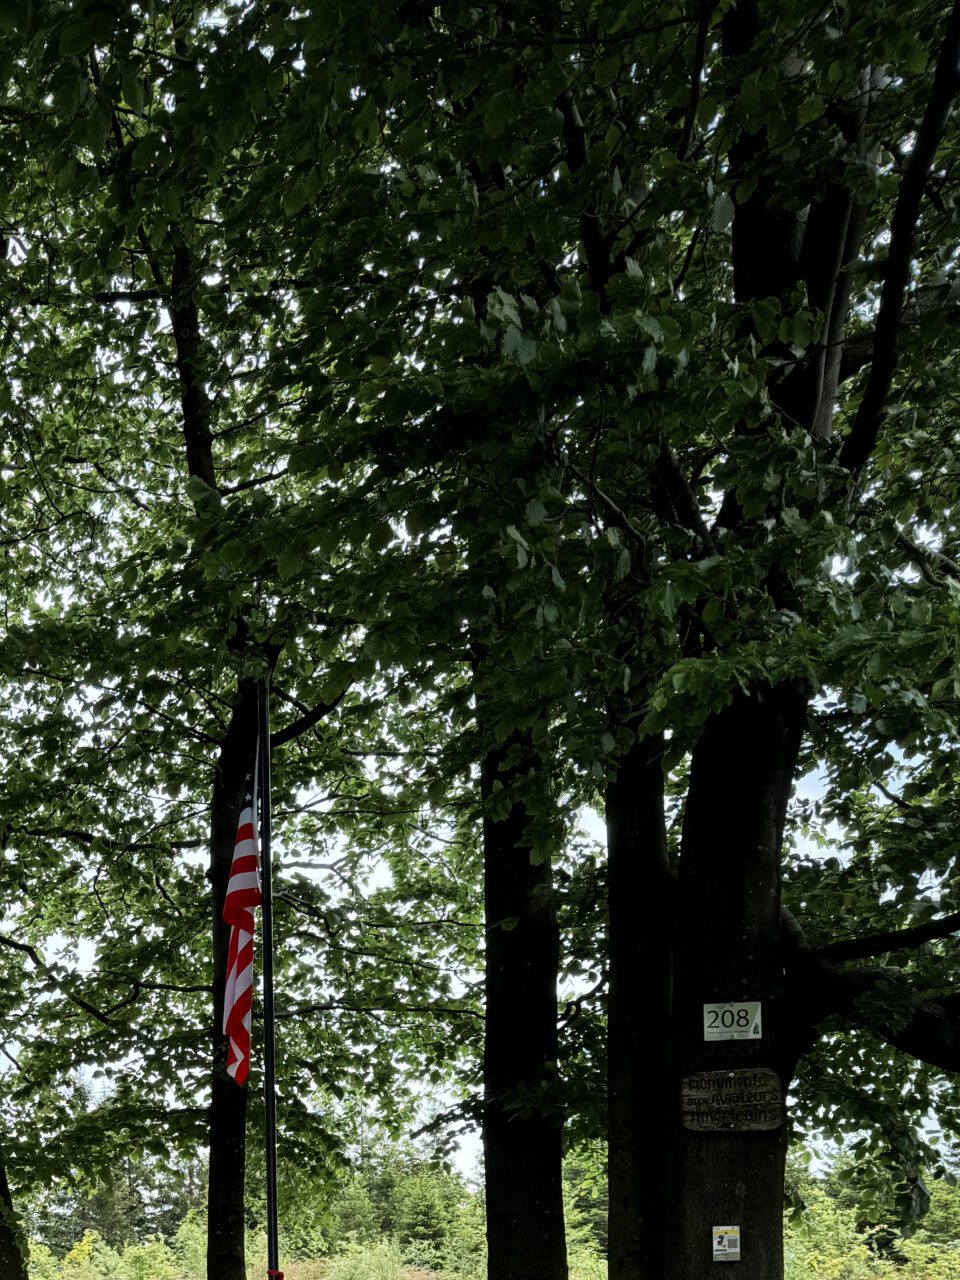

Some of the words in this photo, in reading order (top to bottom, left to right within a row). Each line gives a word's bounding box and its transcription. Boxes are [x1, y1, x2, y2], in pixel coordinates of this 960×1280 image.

[706, 1008, 750, 1029] 208
[688, 1073, 757, 1091] Monument
[686, 1096, 709, 1107] aux
[711, 1089, 779, 1106] Aviateurs
